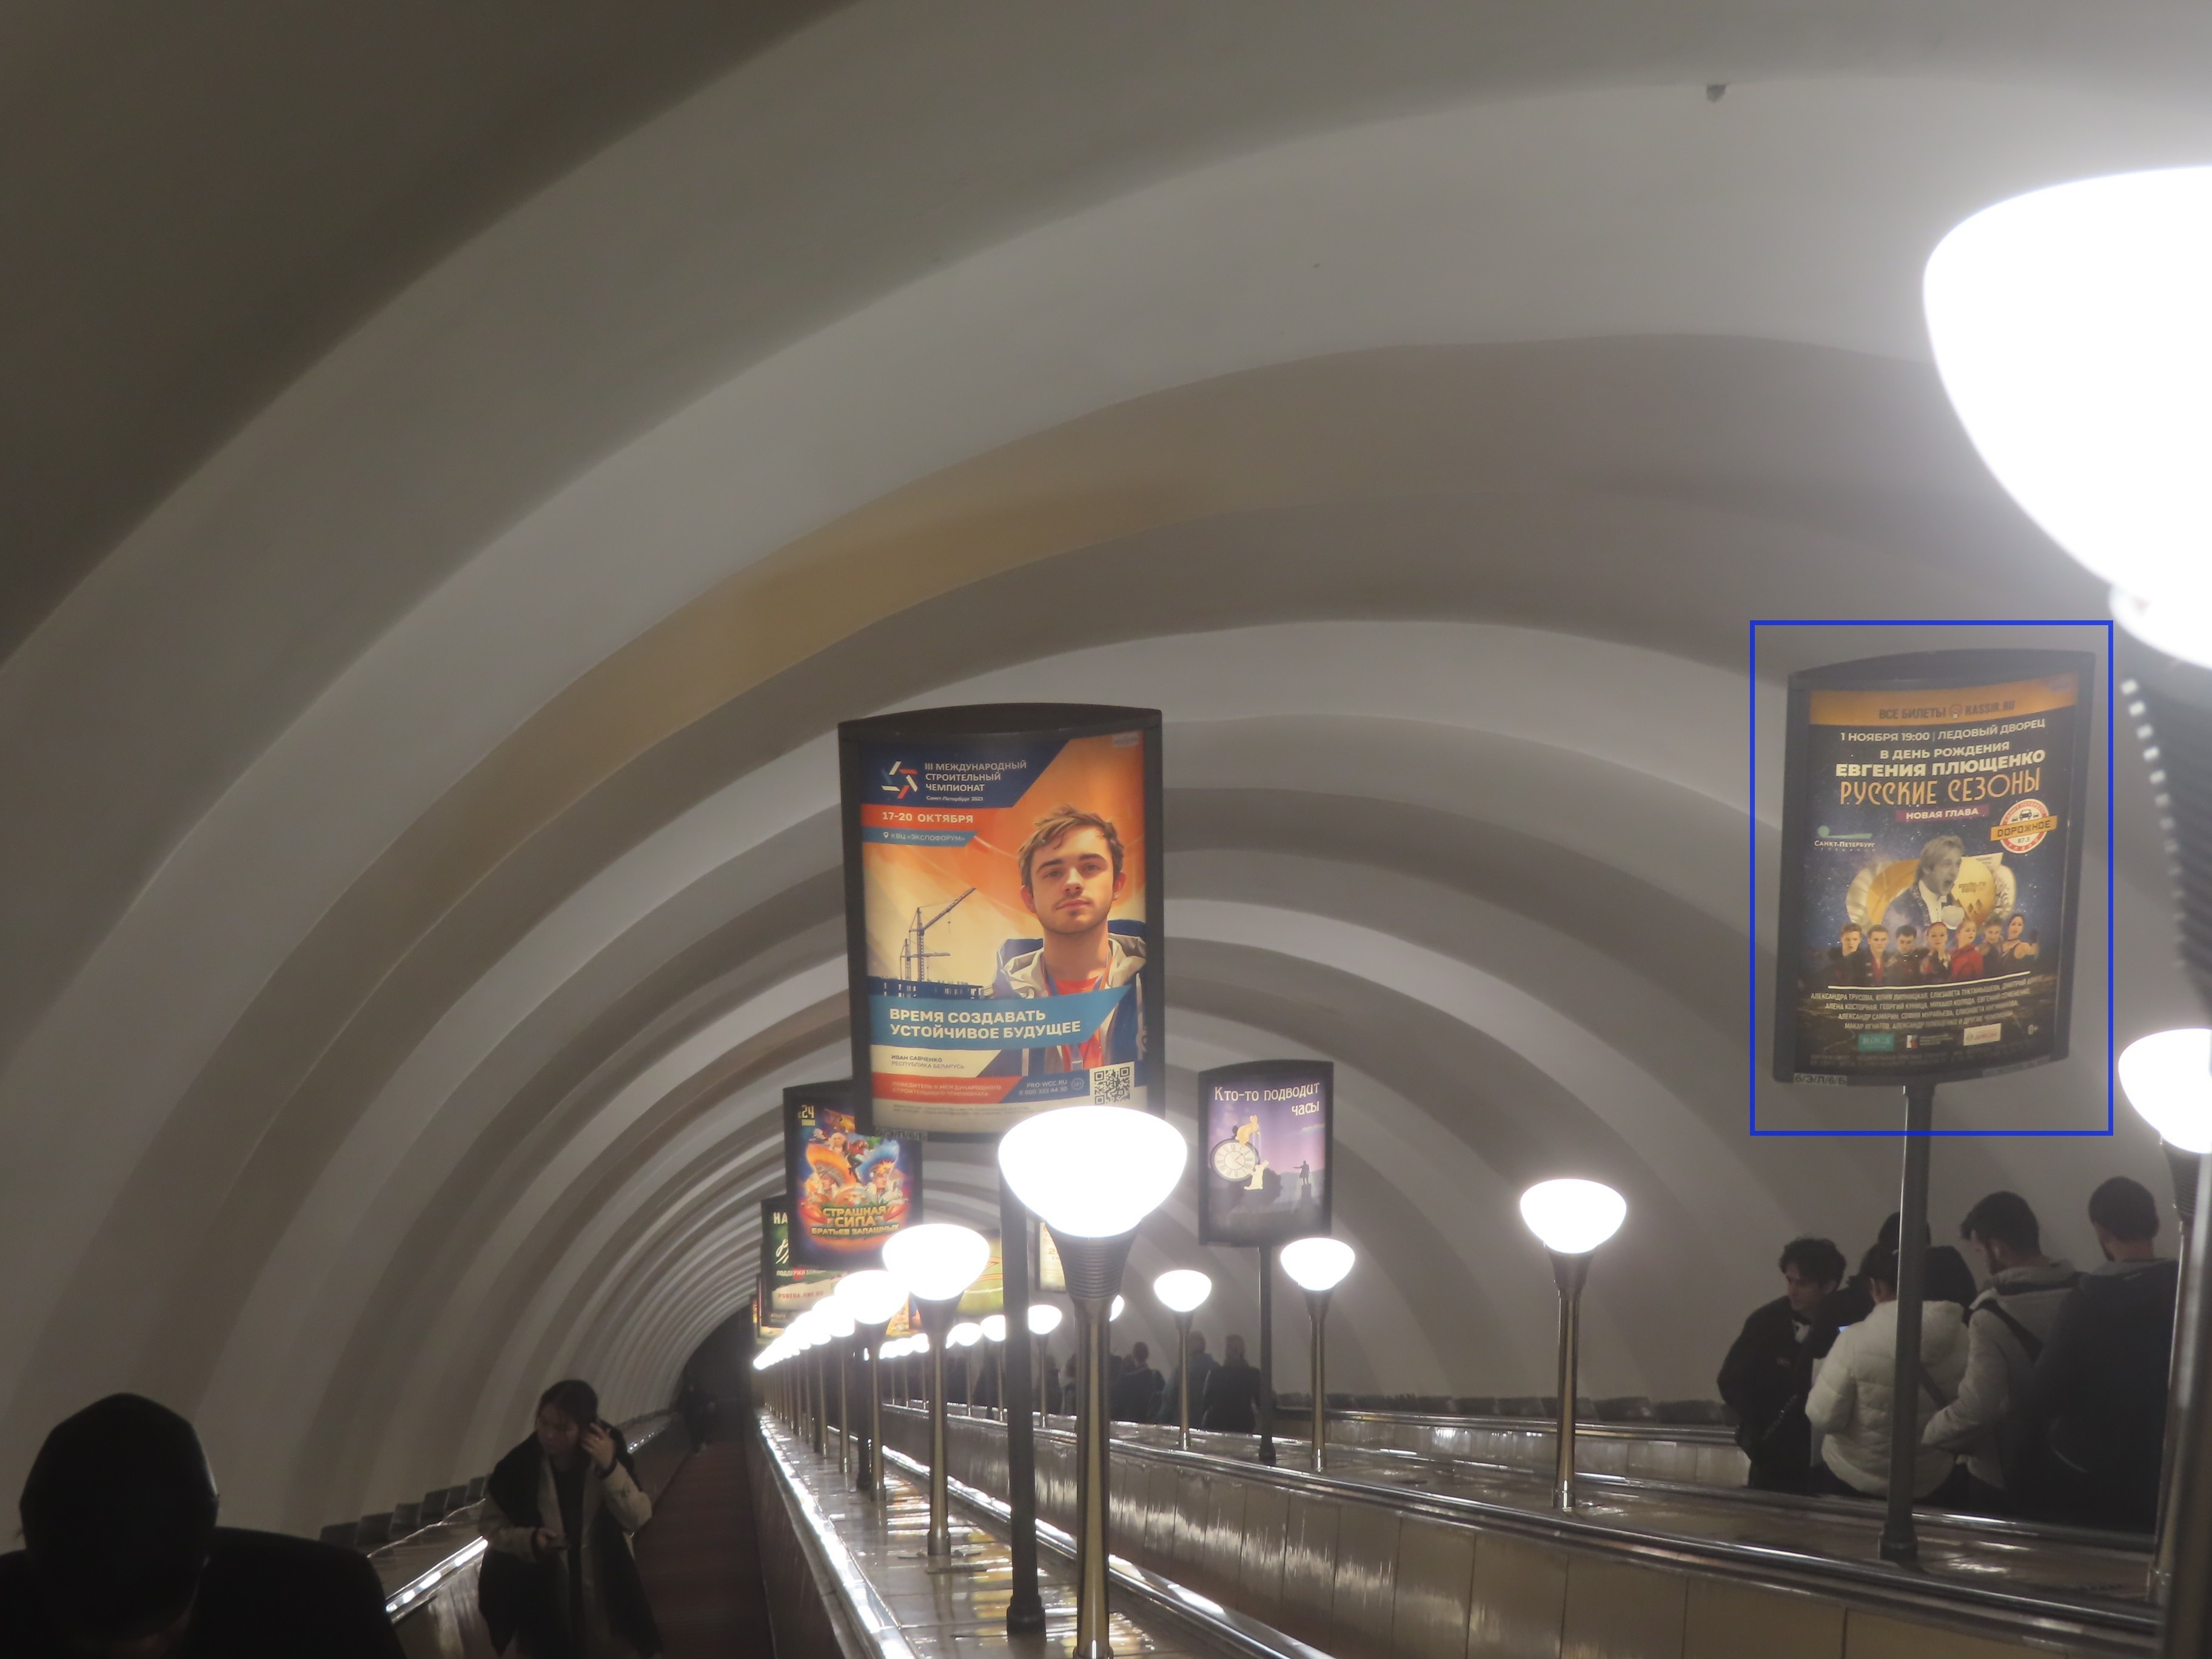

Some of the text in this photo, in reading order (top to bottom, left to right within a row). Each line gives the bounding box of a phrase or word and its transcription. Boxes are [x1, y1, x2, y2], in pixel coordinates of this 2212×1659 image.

[1879, 707, 1946, 719] ВСЕ БИЛЕТЫ
[1965, 700, 2016, 716] KASSIR.RU
[1841, 718, 2046, 742] 1 НОЯБРЯ 19:00 ЛЕДОВЫЙ ДВОРЕЦ
[1880, 741, 2010, 760] В ДЕНЬ РОЖДЕНИЯ
[936, 760, 1027, 772] МЕЖДУНАРОДНЫЙ
[1835, 749, 2046, 777] ЕВГЕНИЯ ПЛЮЩЕНКО
[925, 772, 1002, 782] СТРОИТЕЛЬНЫЙ
[925, 783, 985, 792] ЧЕМПИОНАТ
[1840, 767, 2040, 805] РУССКИЕ СЕЗОНЫ
[882, 811, 973, 823] 17-20 ОКТЯБРЯ
[1906, 807, 1979, 820] НОВАЯ ГЛАВА
[1997, 820, 2051, 837] ДОРОЖНОЕ
[890, 1008, 1046, 1025] ВРЕМЯ СОЗДАВАТЬ
[890, 1020, 1081, 1039] УСТОЙЧИВОЕ БУДУЩЕЕ
[1215, 1082, 1320, 1101] Кто-то подводит
[1292, 1101, 1319, 1116] часы
[823, 1205, 886, 1217] СТРАШНАЯ
